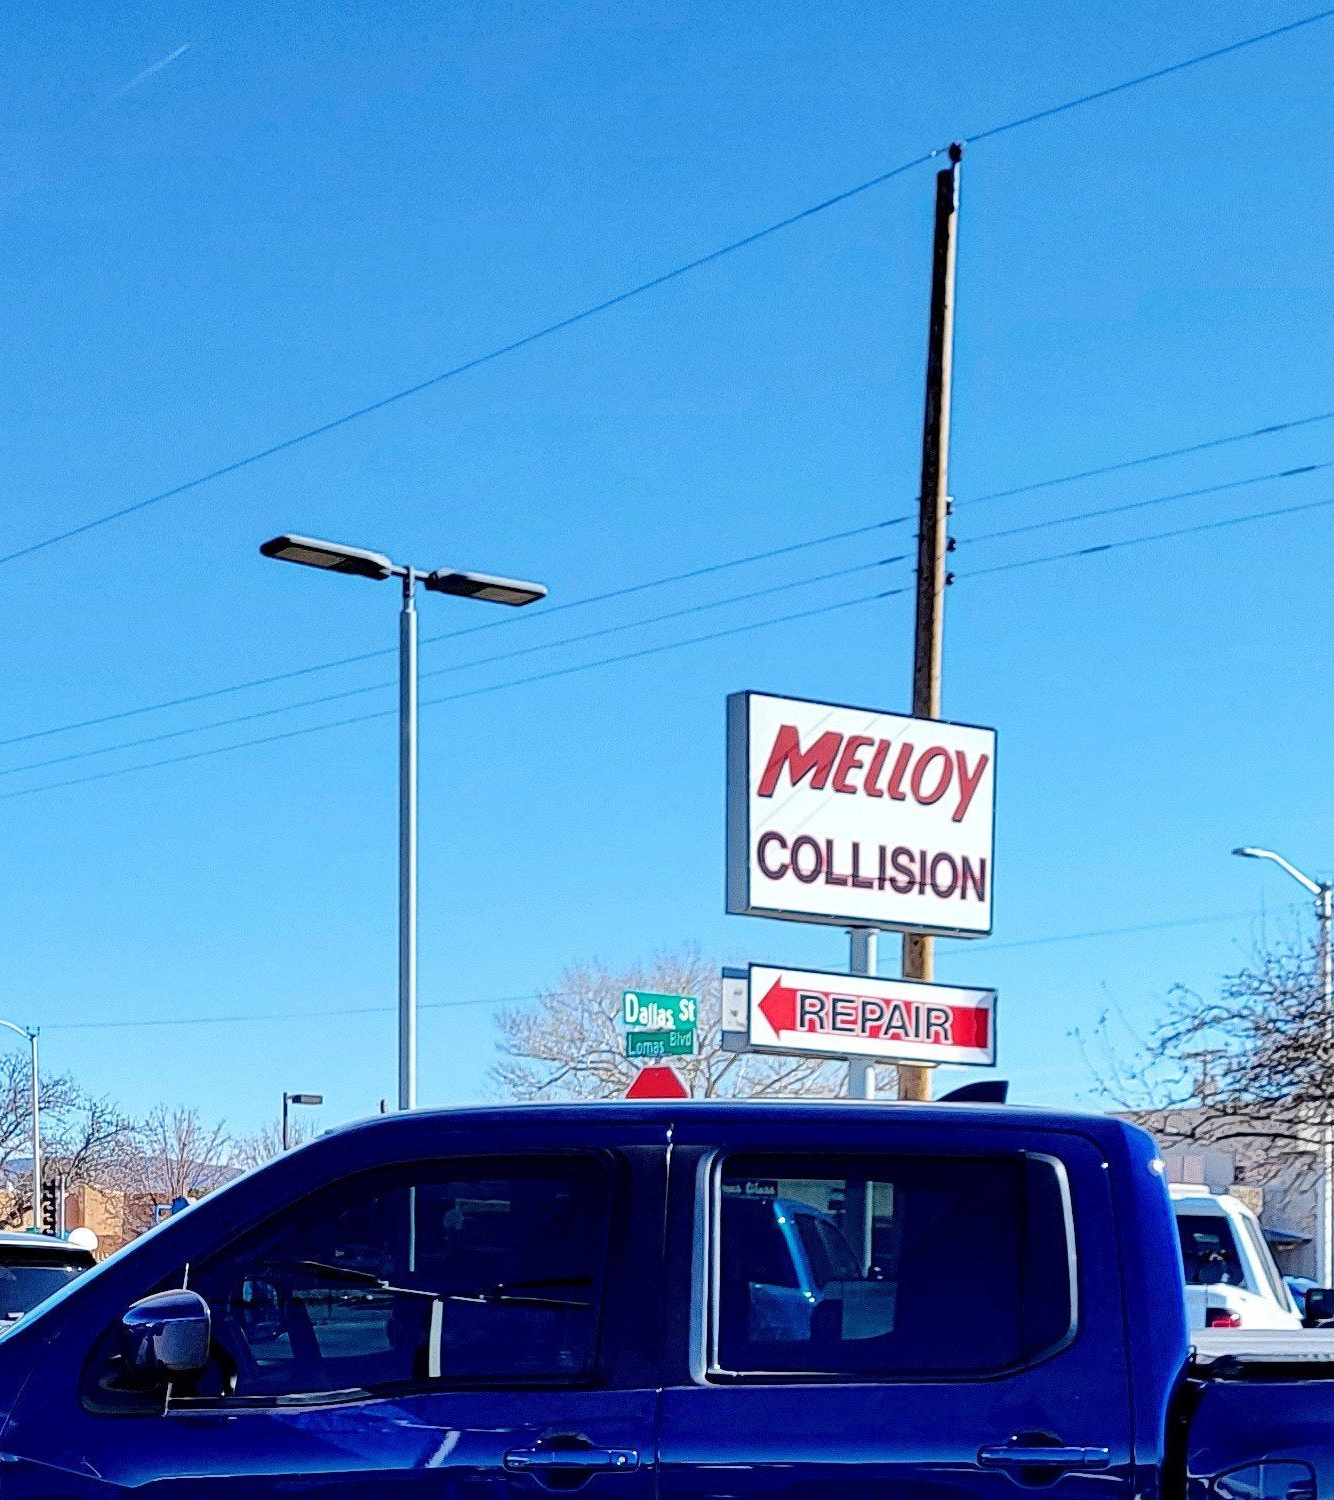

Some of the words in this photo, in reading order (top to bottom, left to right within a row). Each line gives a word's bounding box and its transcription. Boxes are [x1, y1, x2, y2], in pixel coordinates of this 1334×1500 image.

[757, 724, 989, 823] MELLOY
[756, 831, 986, 902] COLLISION
[625, 993, 675, 1029] Dallas
[678, 998, 696, 1022] St
[797, 992, 953, 1042] REPAIR
[628, 1034, 665, 1056] Lomas
[669, 1031, 692, 1047] Blvd
